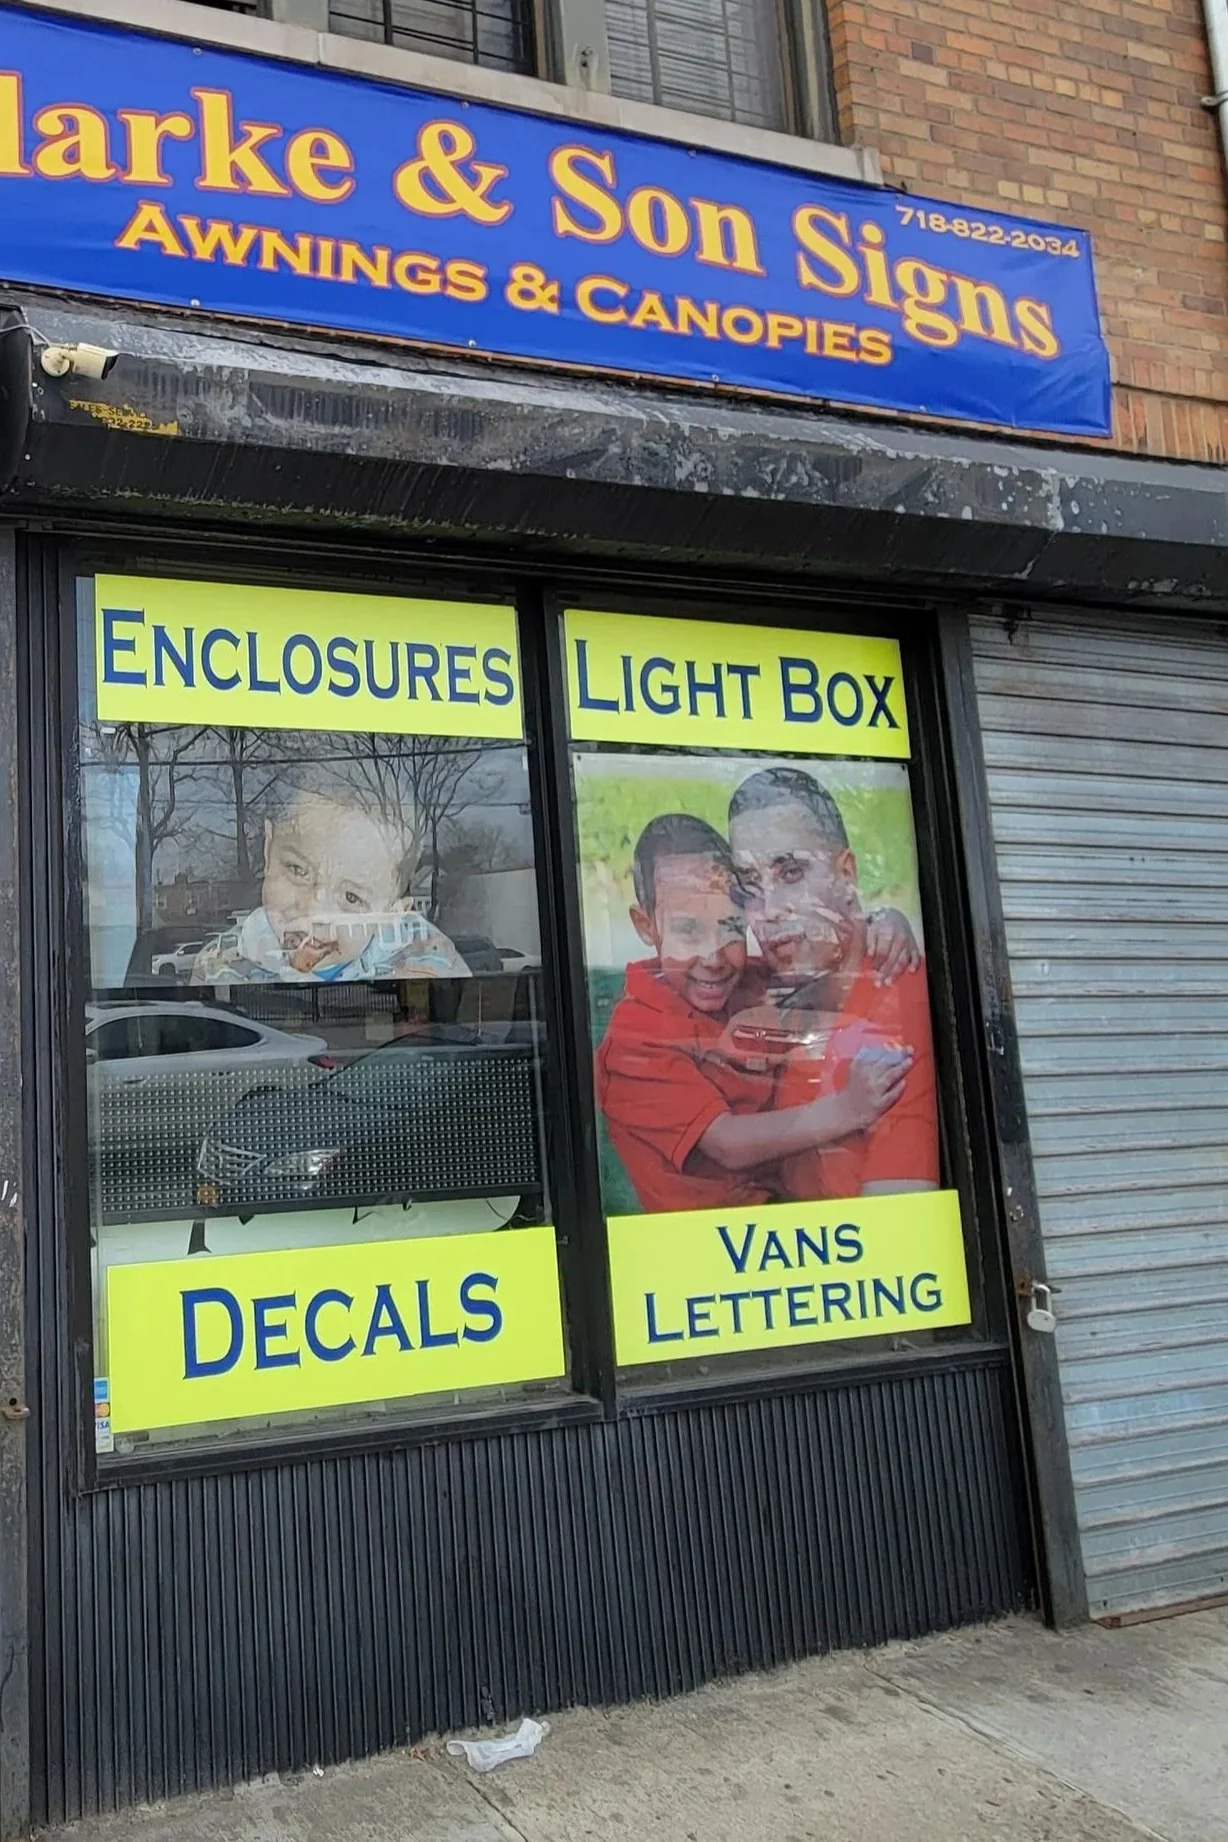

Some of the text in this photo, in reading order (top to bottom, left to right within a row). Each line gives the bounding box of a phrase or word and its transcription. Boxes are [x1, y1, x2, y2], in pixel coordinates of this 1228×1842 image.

[392, 118, 514, 226] &
[548, 144, 767, 277] Son
[791, 203, 1062, 362] Signs
[895, 204, 1081, 258] 718-822-2034
[114, 200, 895, 367] AWNINGS & CANOPIES
[101, 607, 516, 706] ENCLOSURES
[574, 639, 902, 729] LIGHT BOX
[716, 1223, 864, 1274] VANS
[179, 1272, 503, 1380] DECALS
[644, 1272, 944, 1345] LETTERING
